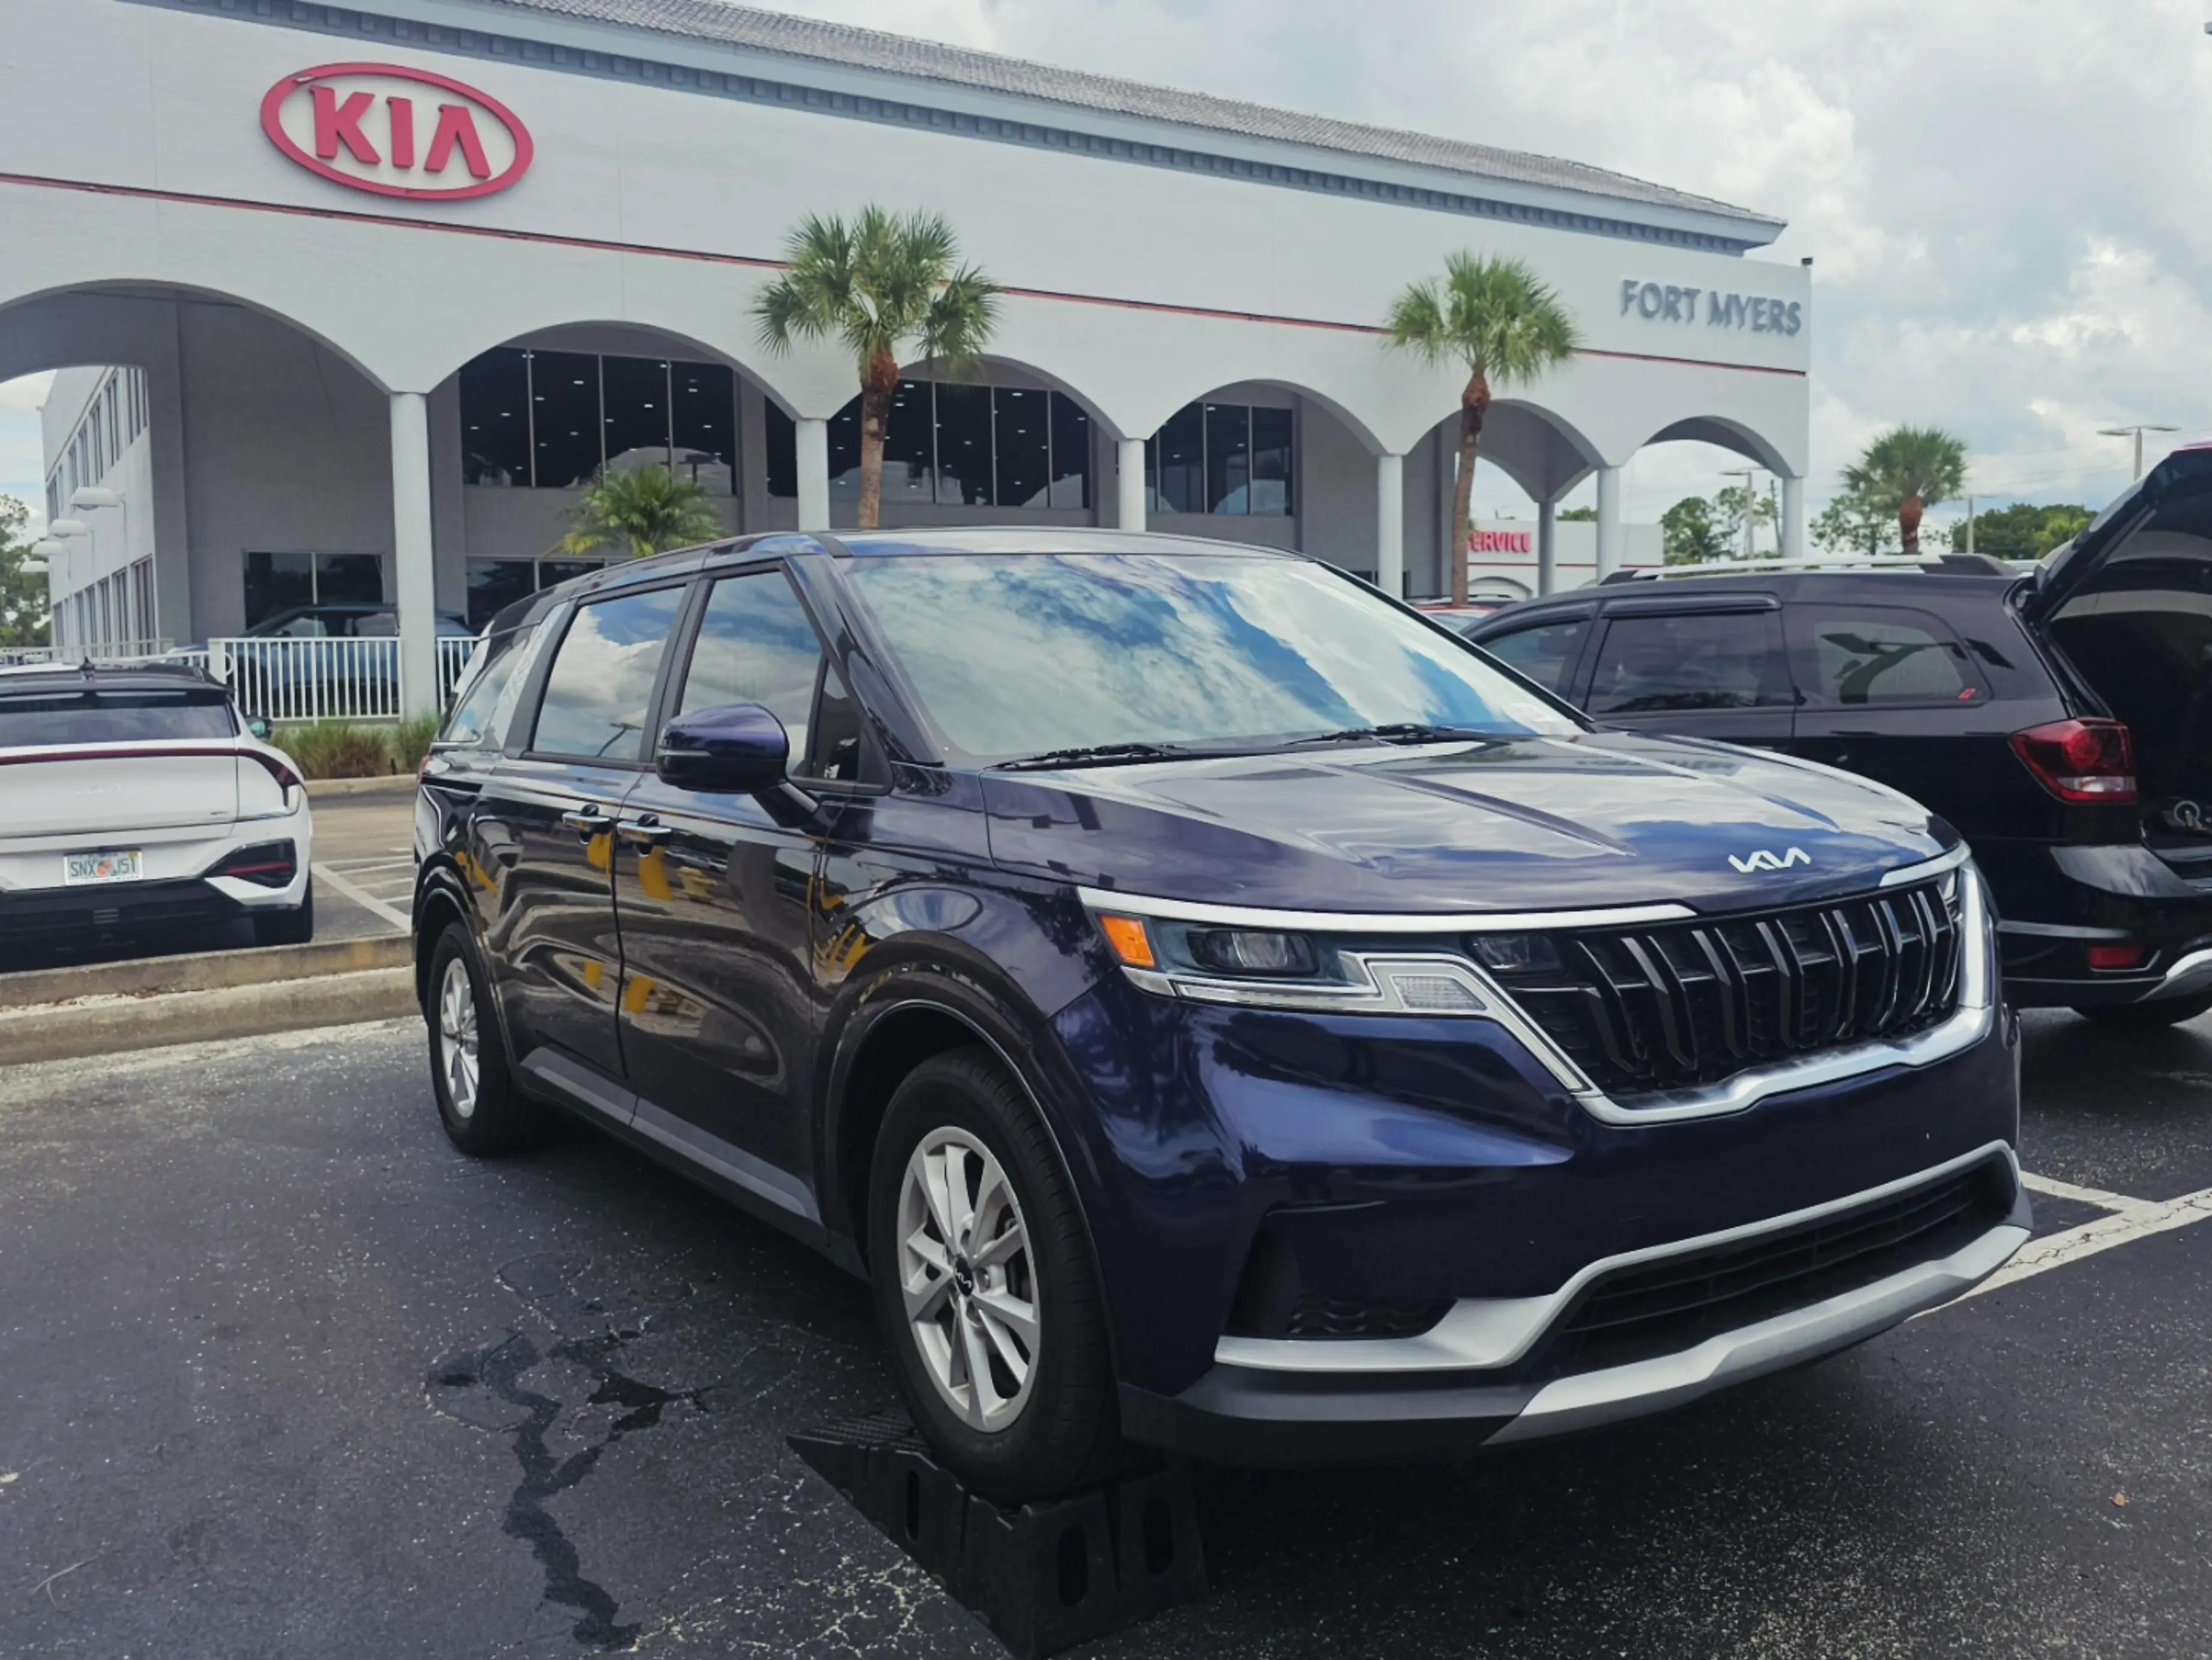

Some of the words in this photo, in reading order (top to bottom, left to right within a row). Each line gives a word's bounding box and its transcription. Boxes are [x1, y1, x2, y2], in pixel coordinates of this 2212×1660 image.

[309, 85, 492, 179] KIA
[1620, 279, 1702, 324] FORT
[1706, 290, 1801, 337] MYERS
[1467, 530, 1531, 553] ERVICE
